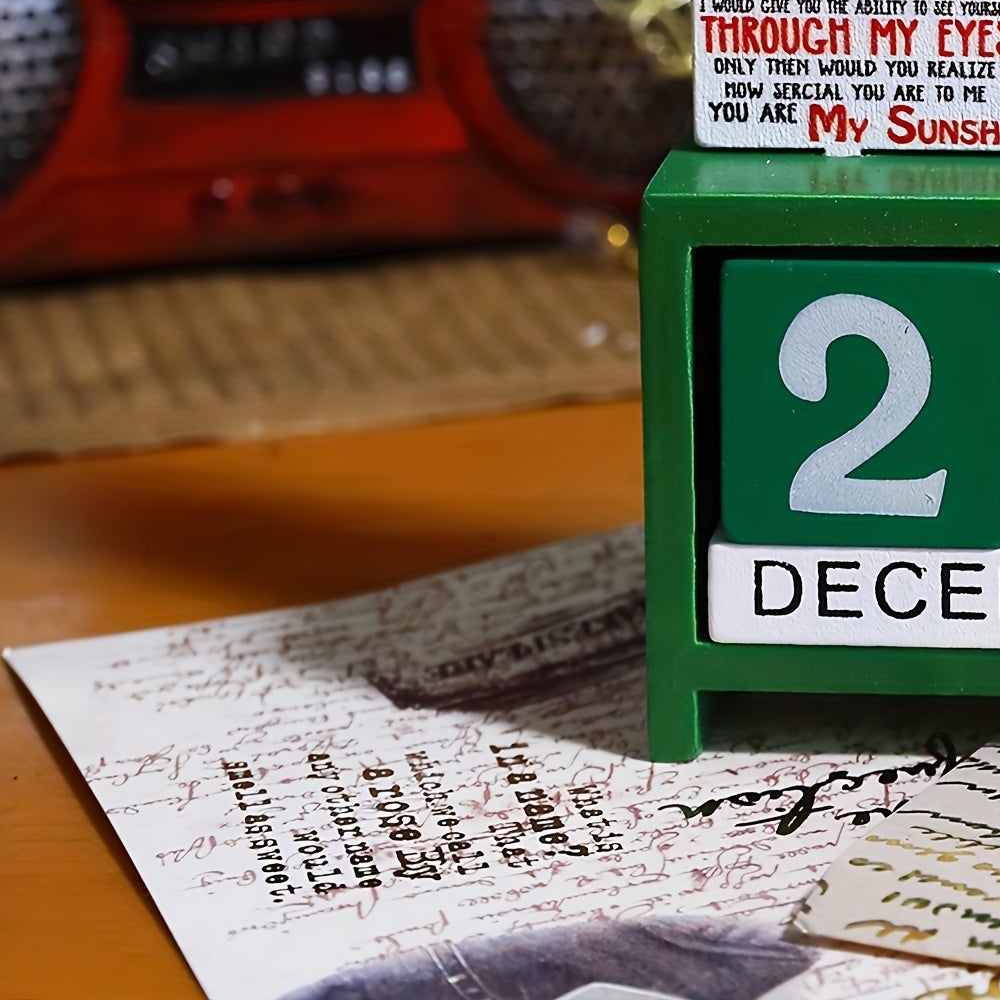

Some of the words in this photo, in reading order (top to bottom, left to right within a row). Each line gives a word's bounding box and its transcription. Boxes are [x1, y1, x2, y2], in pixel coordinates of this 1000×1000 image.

[796, 0, 821, 14] YOU
[827, 0, 849, 14] THE
[855, 0, 907, 15] ABILITY
[913, 0, 927, 16] TO
[934, 1, 954, 16] SEE
[700, 16, 850, 55] THROUGH
[714, 58, 756, 75] ONLY
[766, 58, 809, 76] THEN
[818, 59, 877, 77] WOULD
[885, 61, 918, 77] YOU
[927, 61, 995, 80] REALIZE
[851, 84, 885, 101] YOU
[894, 85, 924, 102] ARE
[935, 85, 954, 102] TO
[964, 86, 986, 103] ME
